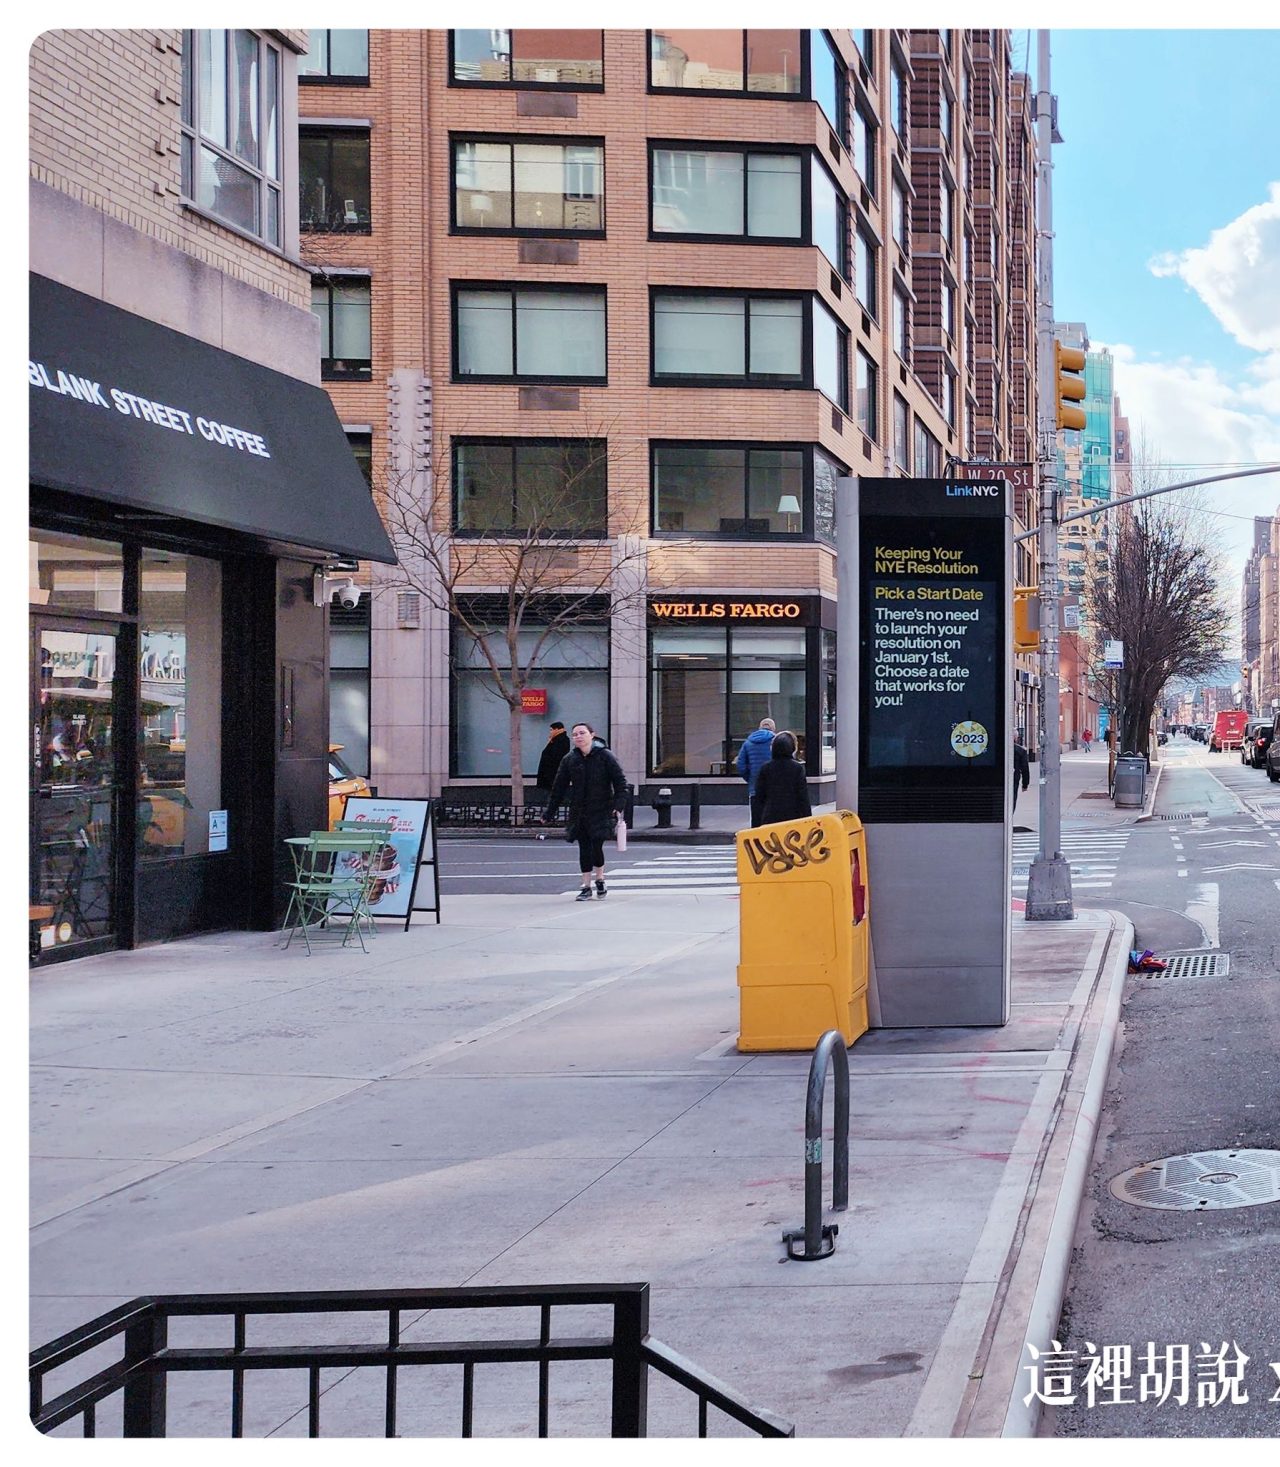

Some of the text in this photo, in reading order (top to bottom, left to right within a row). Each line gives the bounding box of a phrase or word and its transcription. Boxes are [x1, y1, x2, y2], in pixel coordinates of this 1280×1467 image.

[29, 361, 271, 458] BLANK STREET COFFEE
[967, 469, 1029, 486] W 20 St
[946, 485, 999, 497] LinkNYC
[875, 546, 963, 561] Keeping Your
[875, 561, 979, 574] NYE Resolution
[875, 587, 984, 600] Pick a Start Date
[652, 603, 800, 618] WELLS FARGO
[875, 607, 979, 621] There's no need
[875, 622, 967, 637] to launch your
[875, 636, 961, 649] resolution on
[875, 651, 952, 665] January 1st.
[875, 665, 970, 677] Choose a date
[875, 679, 966, 691] that works for
[875, 693, 903, 708] you!
[955, 734, 985, 744] 2023
